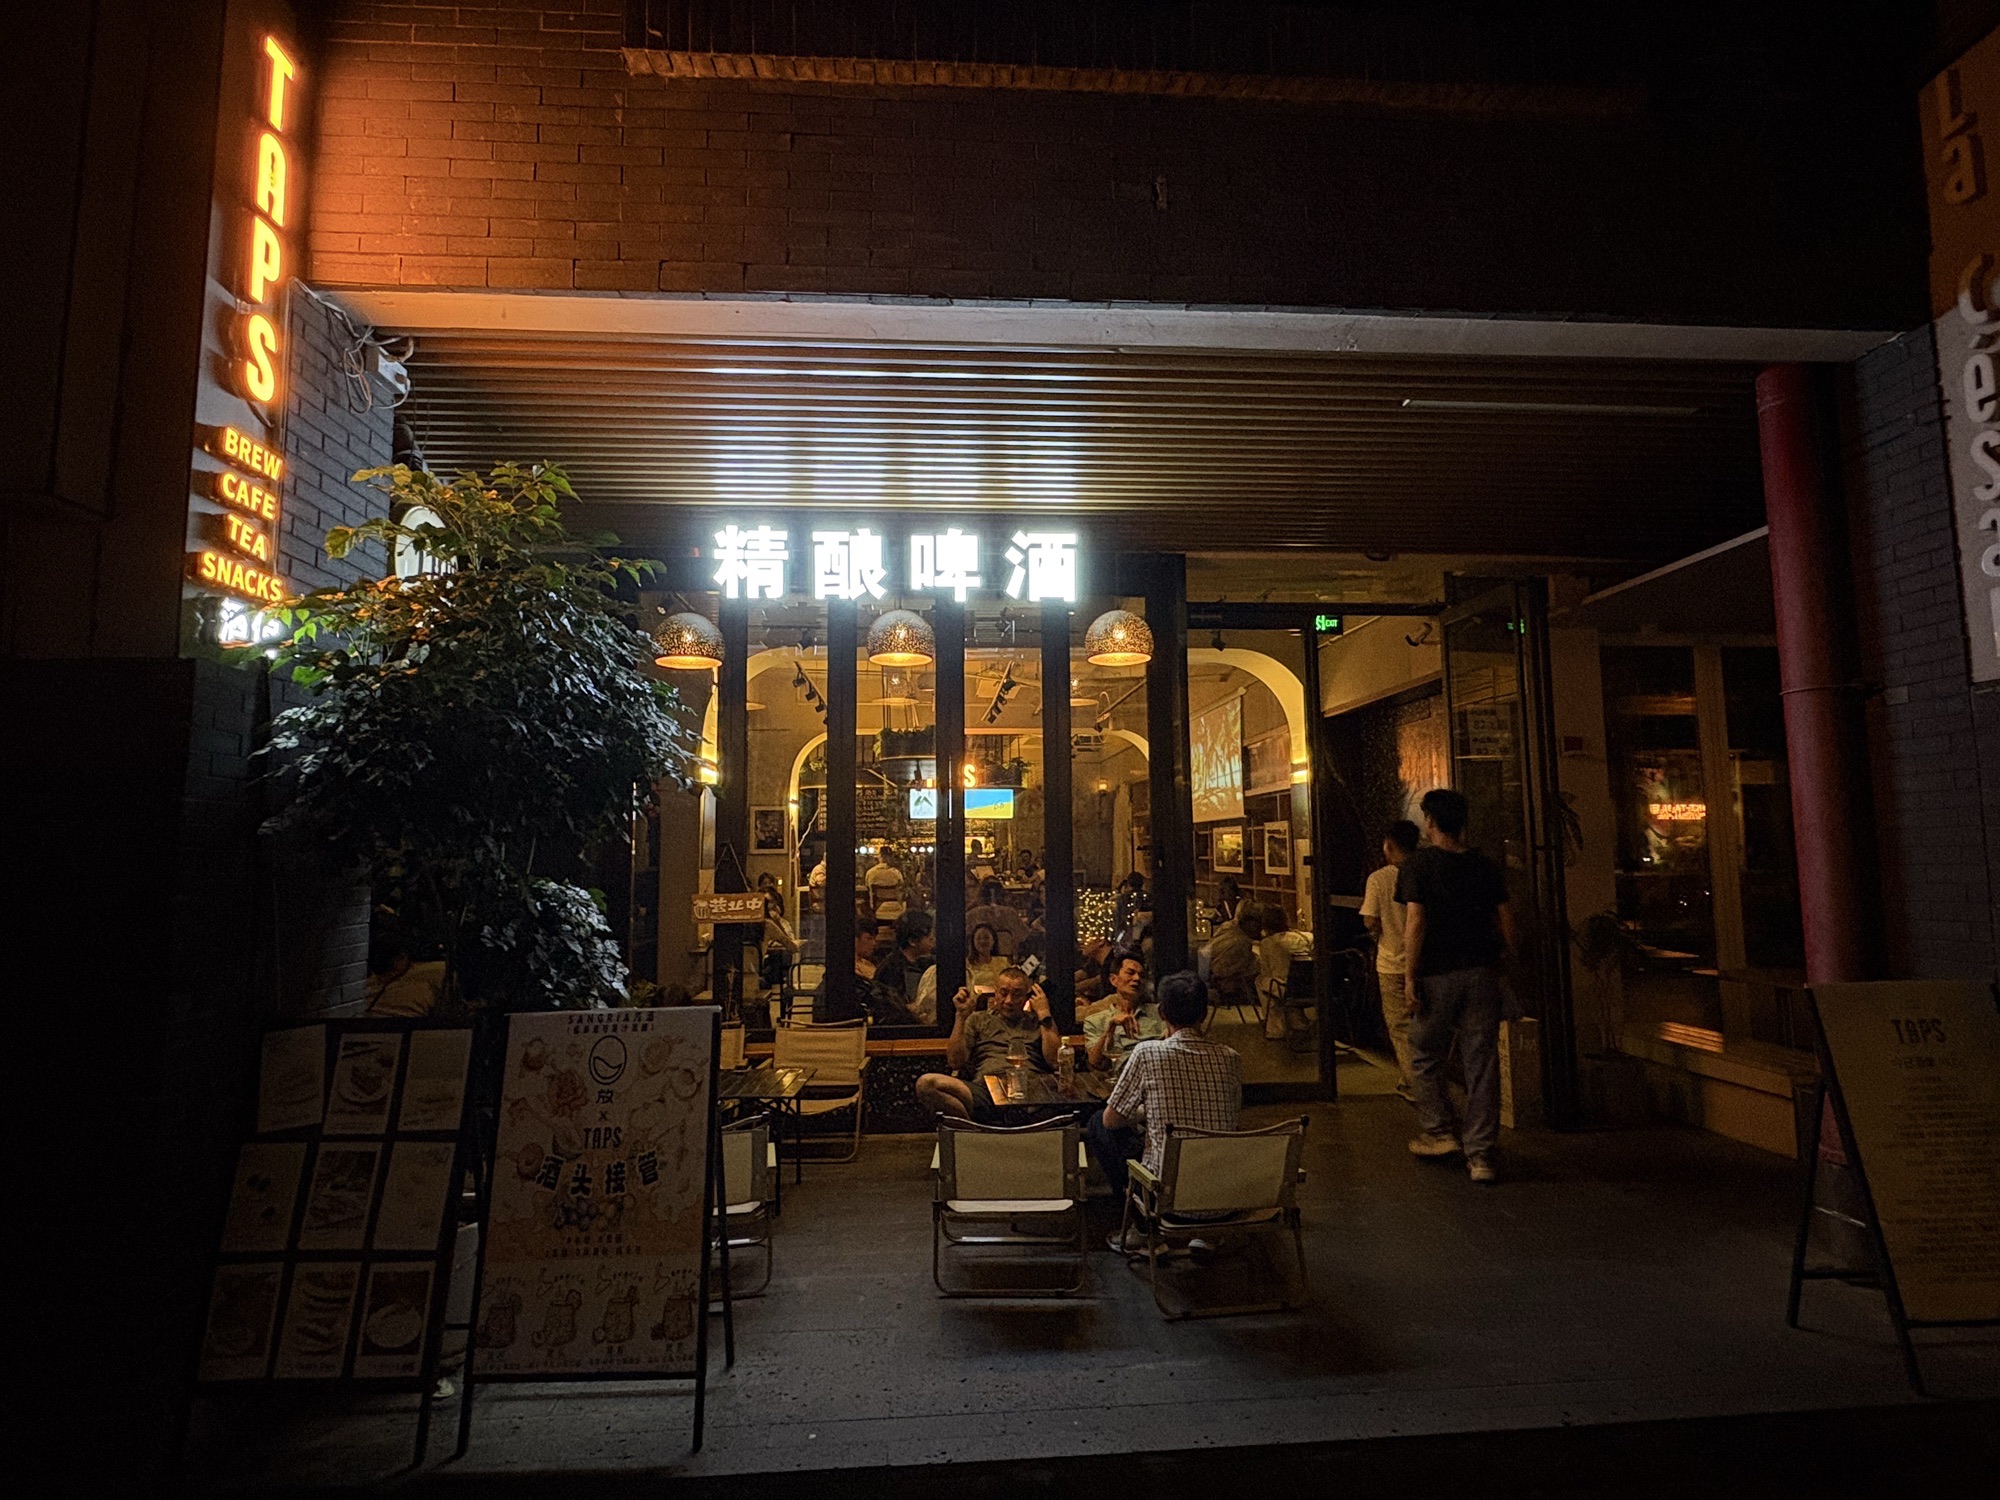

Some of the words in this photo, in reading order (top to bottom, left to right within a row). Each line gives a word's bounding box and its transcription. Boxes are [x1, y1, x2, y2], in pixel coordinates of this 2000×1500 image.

[245, 36, 295, 402] TAPS
[224, 427, 282, 481] BREW
[222, 473, 276, 520] CAFE
[228, 514, 268, 562] TEA
[203, 552, 282, 602] SNACKS
[713, 525, 1078, 602] 精酿啤酒
[583, 1127, 621, 1149] TAPS
[536, 1151, 659, 1196] 酒头接管
